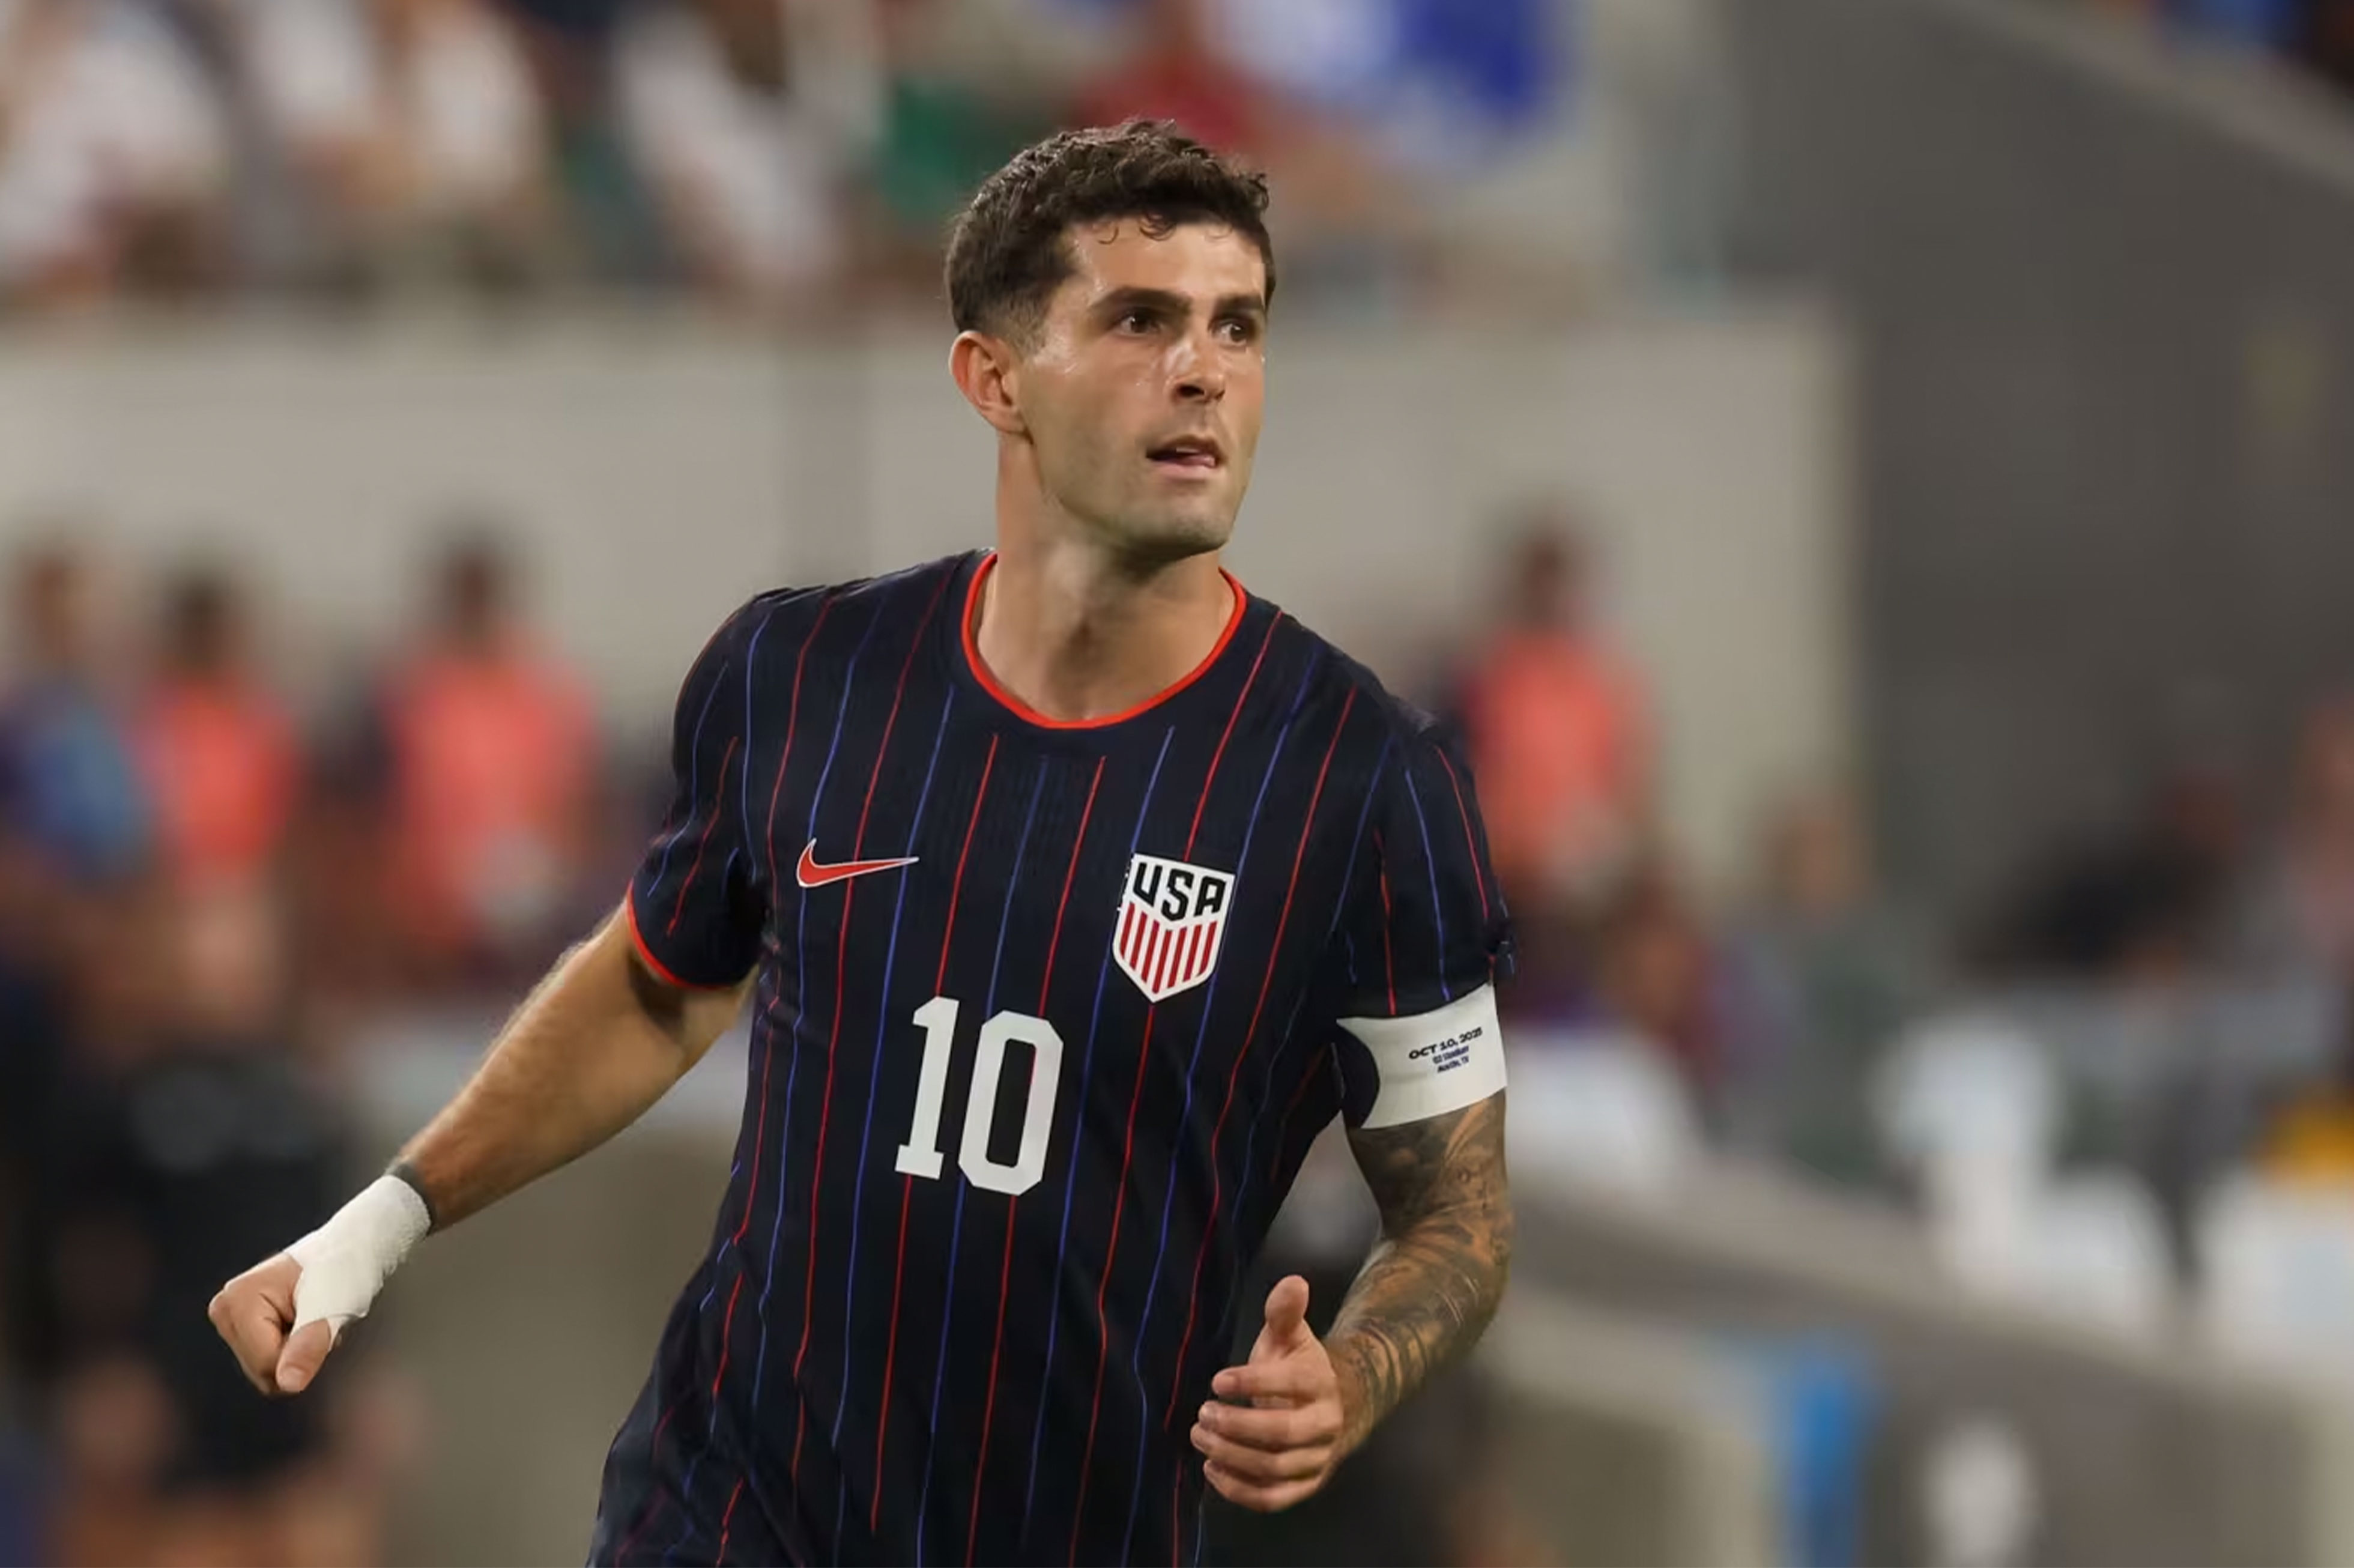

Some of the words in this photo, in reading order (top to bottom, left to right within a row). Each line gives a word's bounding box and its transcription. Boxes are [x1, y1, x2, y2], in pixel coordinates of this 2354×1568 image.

[1132, 862, 1227, 921] USA
[1409, 1044, 1437, 1059] OCT
[1439, 1038, 1458, 1051] 10,
[895, 996, 1064, 1196] 10
